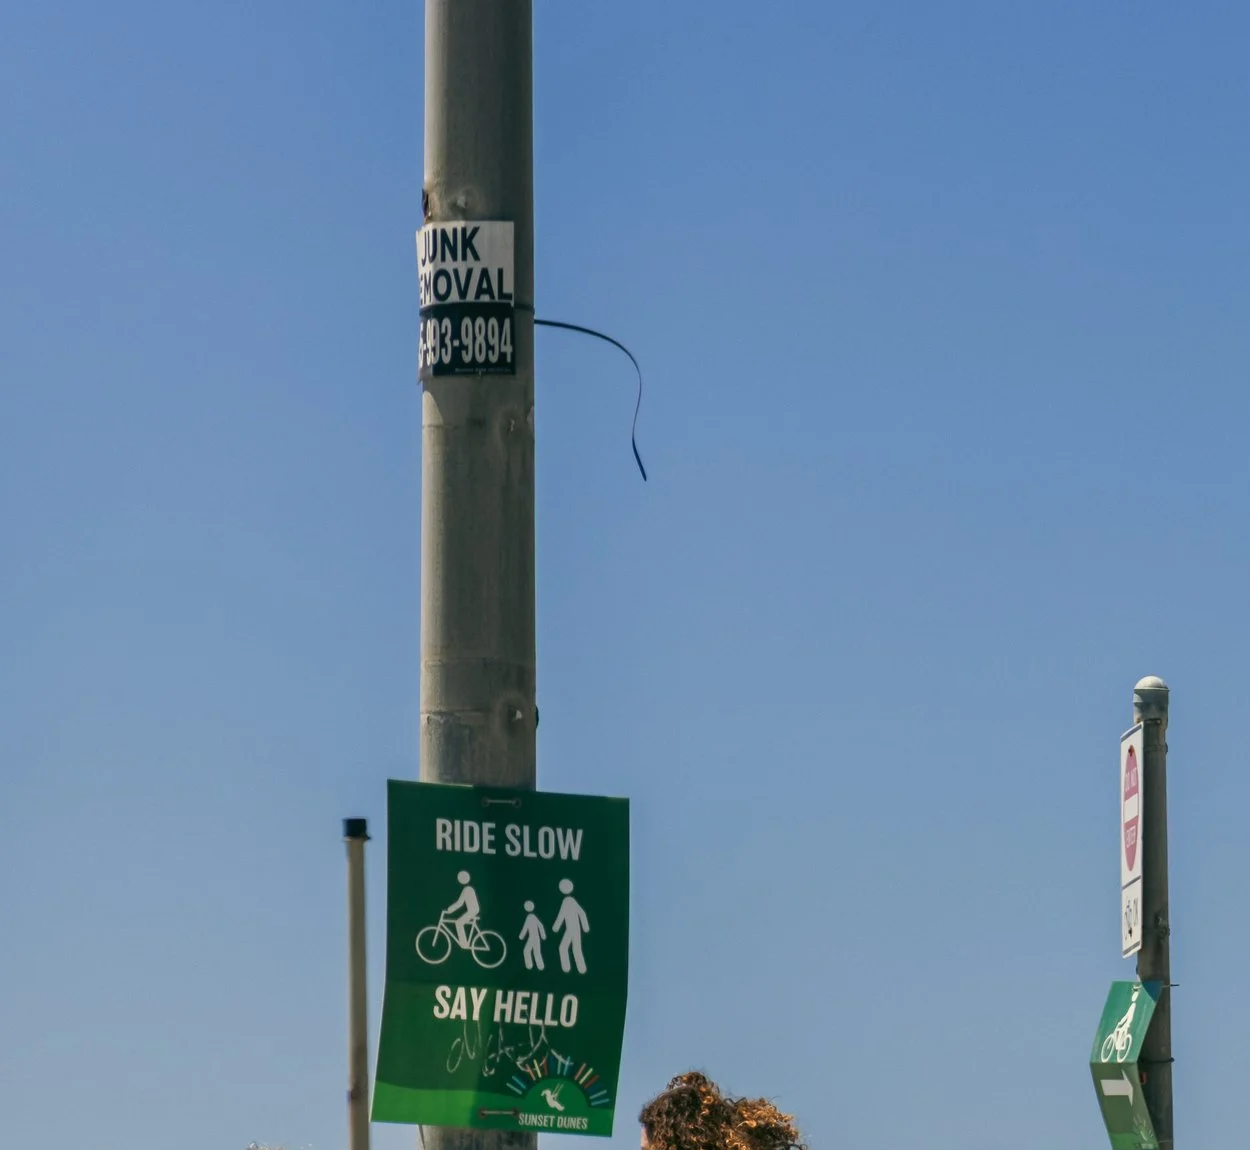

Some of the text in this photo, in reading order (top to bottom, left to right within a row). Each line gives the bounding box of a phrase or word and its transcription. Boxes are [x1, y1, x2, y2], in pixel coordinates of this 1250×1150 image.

[421, 226, 481, 267] JUNK
[435, 817, 583, 861] RIDE SLOW
[433, 985, 579, 1028] SAY HELLO
[518, 1113, 589, 1131] SUNSET DUNES
